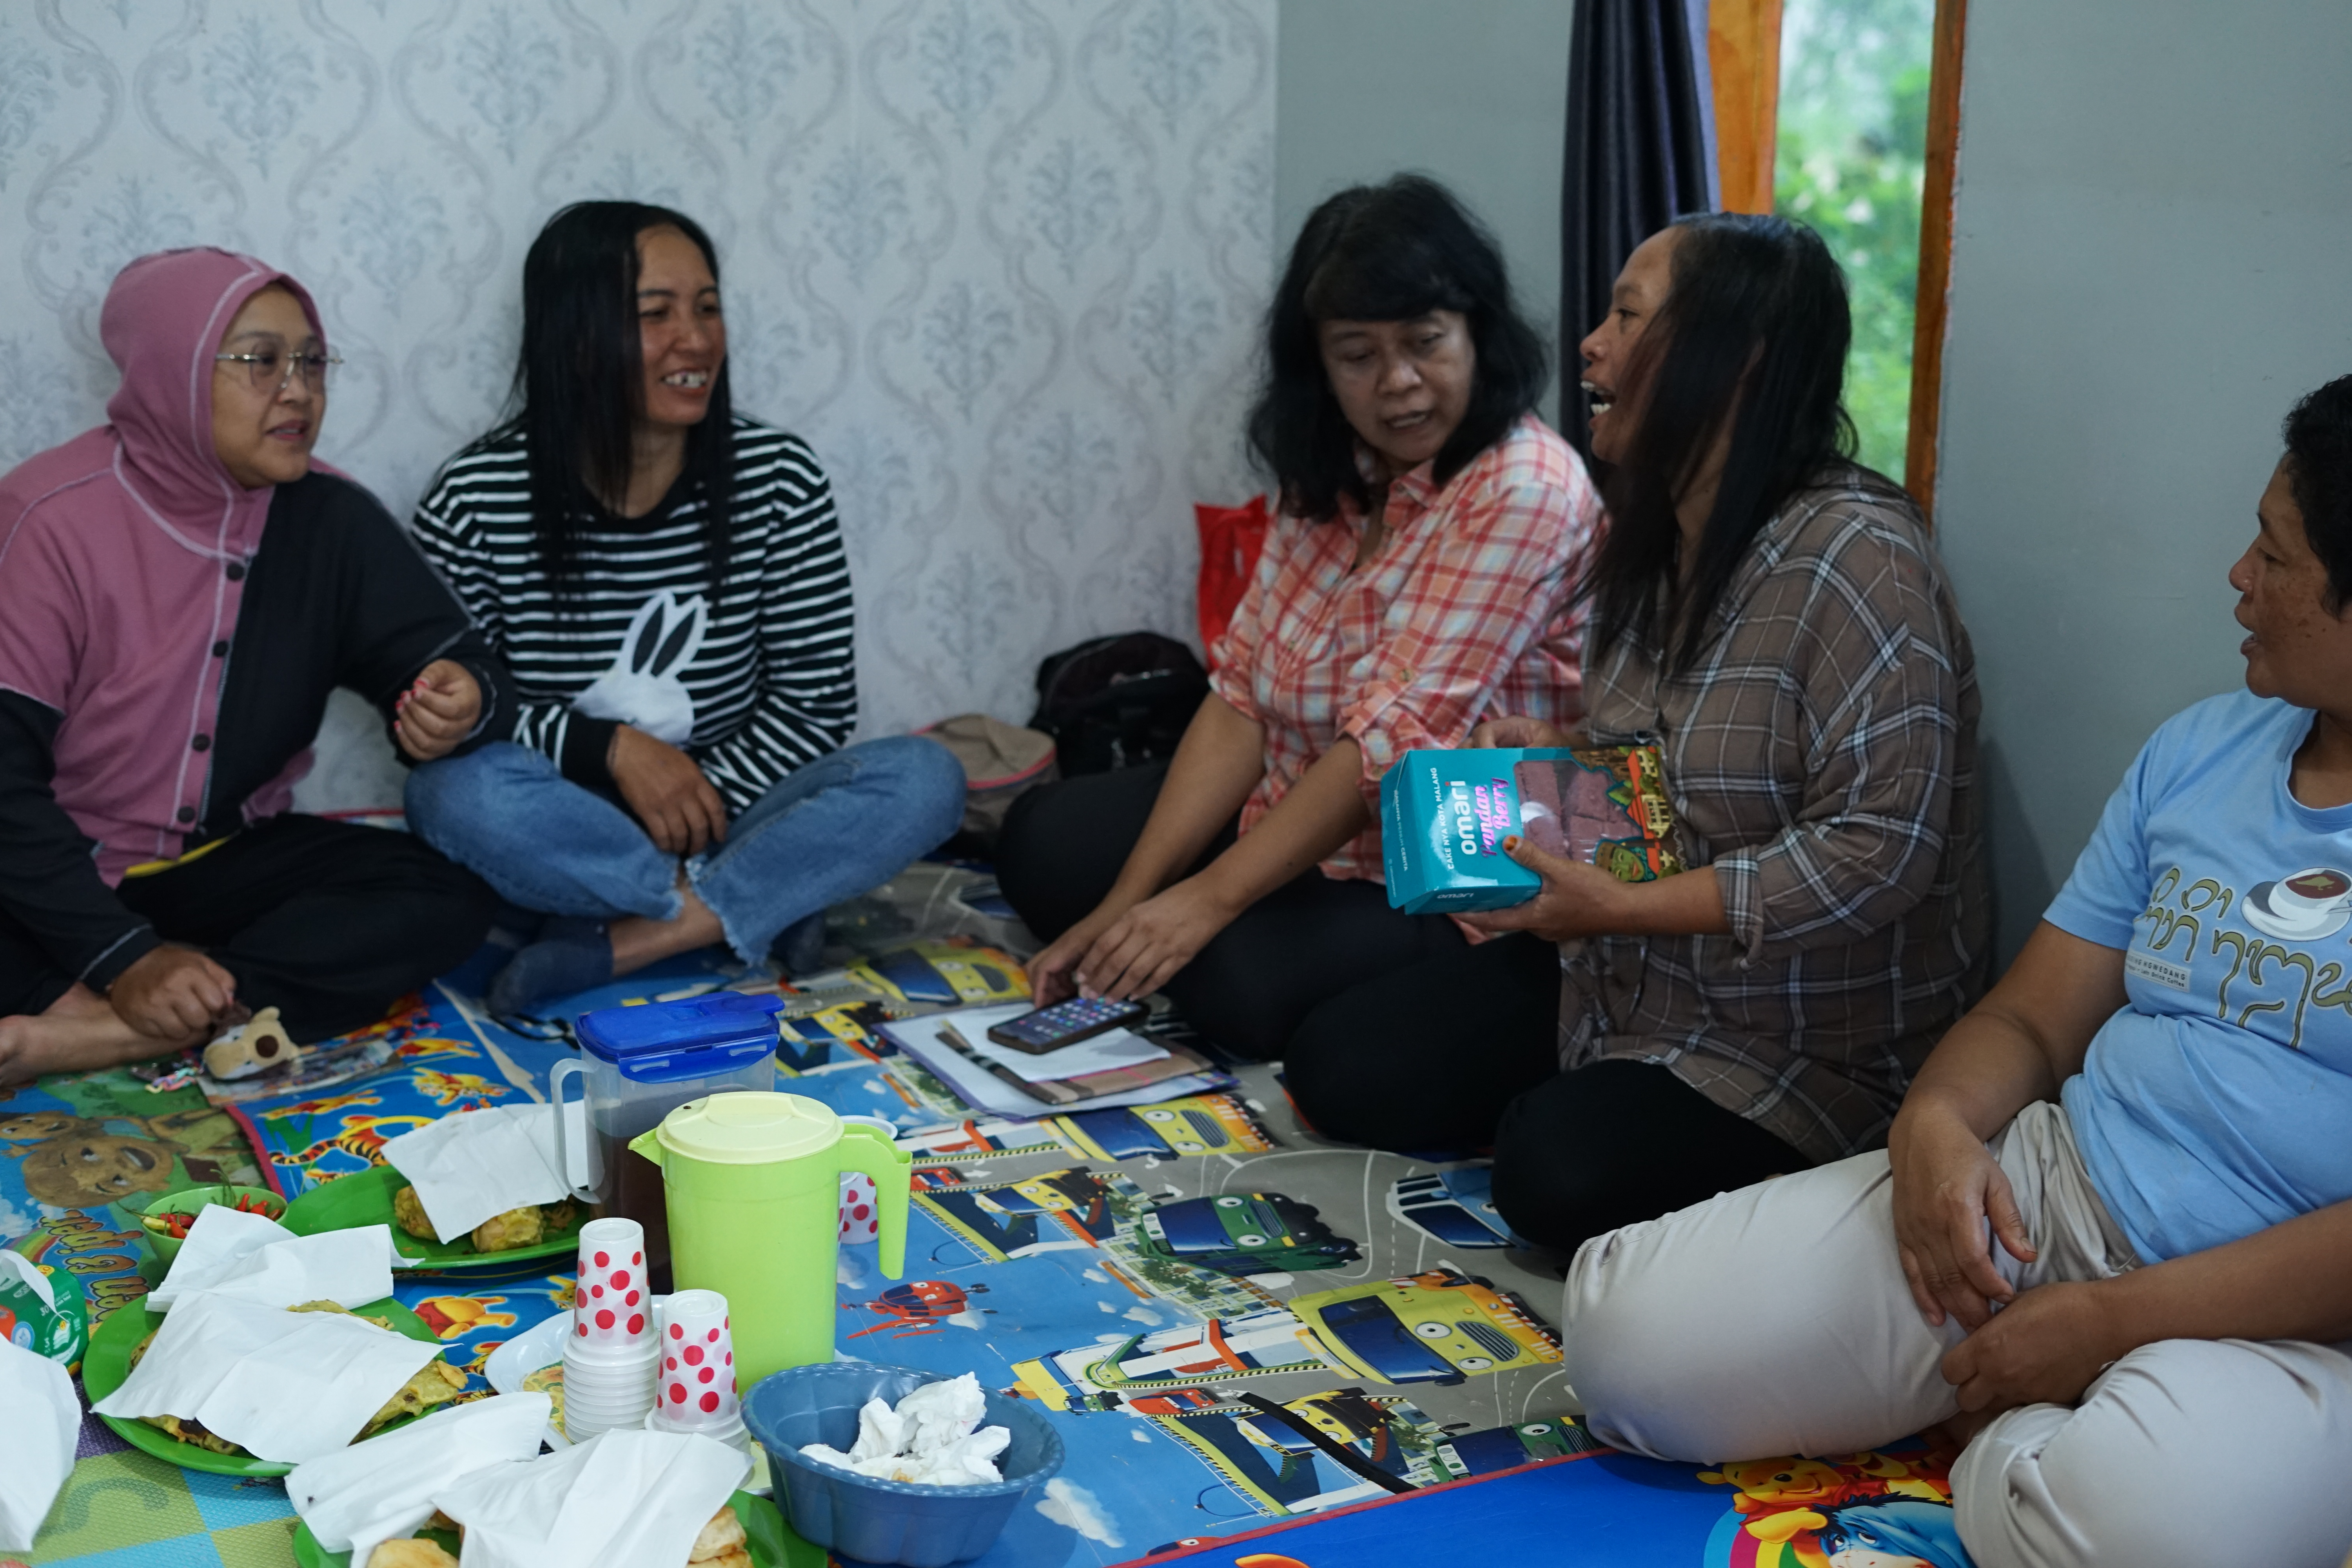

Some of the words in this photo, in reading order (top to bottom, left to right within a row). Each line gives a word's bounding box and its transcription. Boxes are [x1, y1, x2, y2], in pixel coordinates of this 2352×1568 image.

[1430, 768, 1443, 802] MALANG
[1437, 804, 1446, 826] KOTA
[1445, 780, 1477, 855] omari
[1491, 777, 1511, 829] Berry
[1441, 828, 1450, 846] NYA
[1474, 785, 1497, 858] Pandan
[1444, 848, 1454, 869] CAKE
